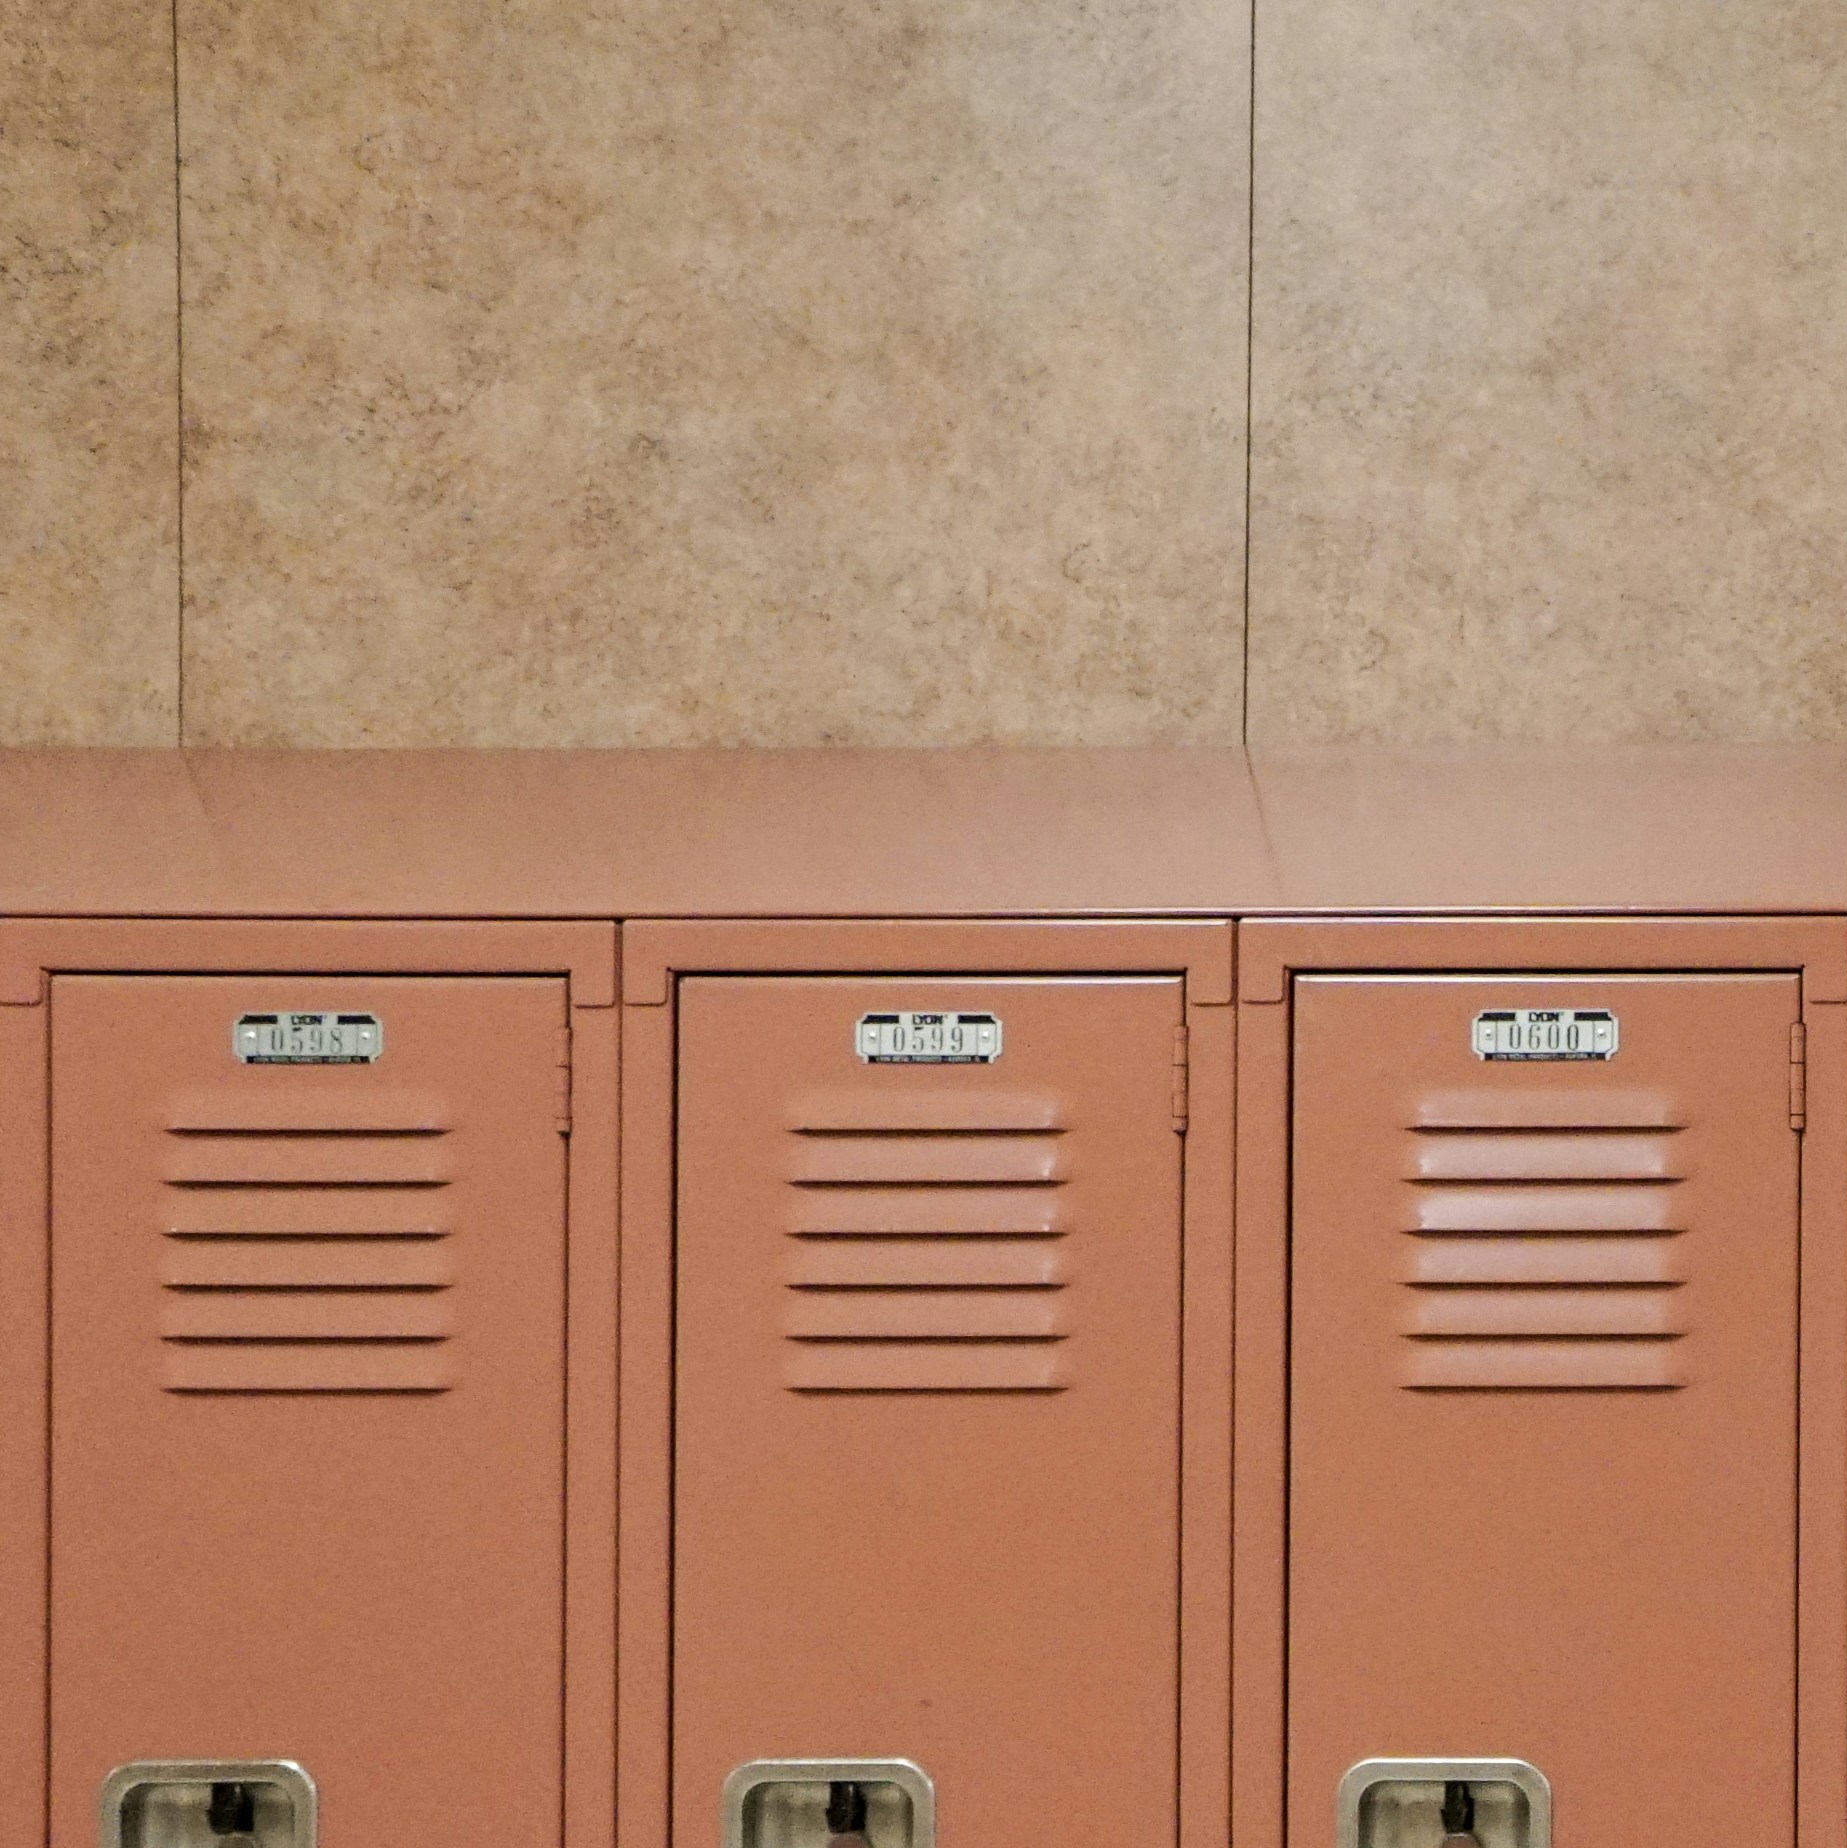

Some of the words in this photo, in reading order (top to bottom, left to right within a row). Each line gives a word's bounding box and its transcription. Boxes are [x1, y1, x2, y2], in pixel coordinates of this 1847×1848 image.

[291, 1016, 322, 1024] LYON
[913, 1015, 944, 1024] LYON
[1529, 1013, 1559, 1021] LYON
[271, 1028, 342, 1053] 0598
[893, 1027, 963, 1052] 0599
[1509, 1024, 1578, 1050] 0600
